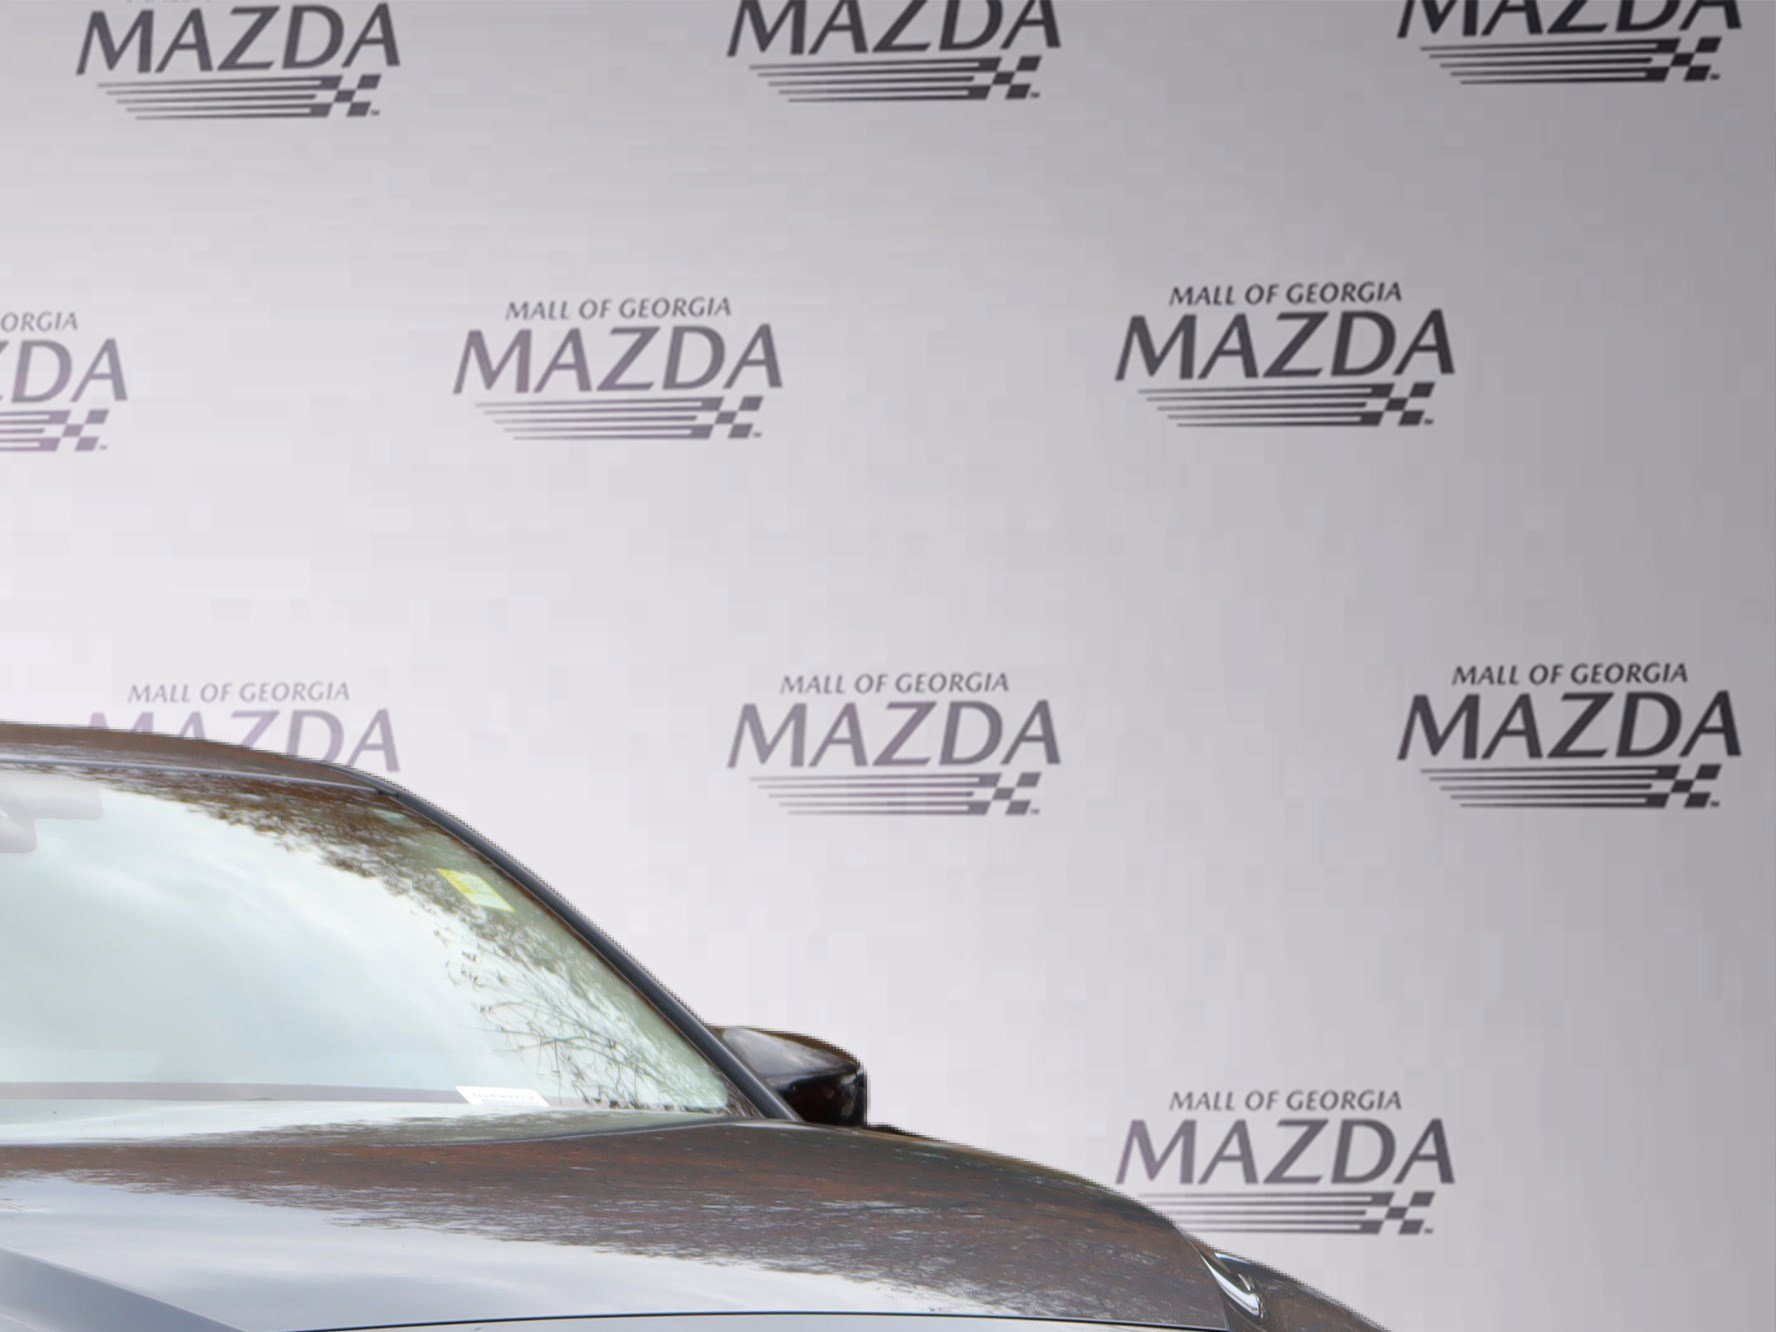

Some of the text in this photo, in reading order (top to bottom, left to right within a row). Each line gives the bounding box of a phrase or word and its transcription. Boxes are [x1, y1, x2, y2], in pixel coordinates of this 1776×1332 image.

[76, 2, 401, 75] MAZDA
[727, 0, 1061, 57] MAZDA
[505, 296, 732, 321] MALL OF GEORGIA
[1169, 281, 1402, 306] MALL OF GEORGIA
[452, 323, 783, 395] MAZDA
[1114, 308, 1455, 382] MAZDA
[128, 681, 350, 704] MALL OF GEORGIA
[780, 671, 1010, 695] MALL OF GEORGIA
[1451, 661, 1688, 686] MALL OF GEORGIA
[727, 699, 1061, 769] MAZDA
[1397, 689, 1742, 761] MAZDA
[1169, 1089, 1402, 1112] MALL OF GEORGIA
[1115, 1117, 1455, 1186] MAZDA
